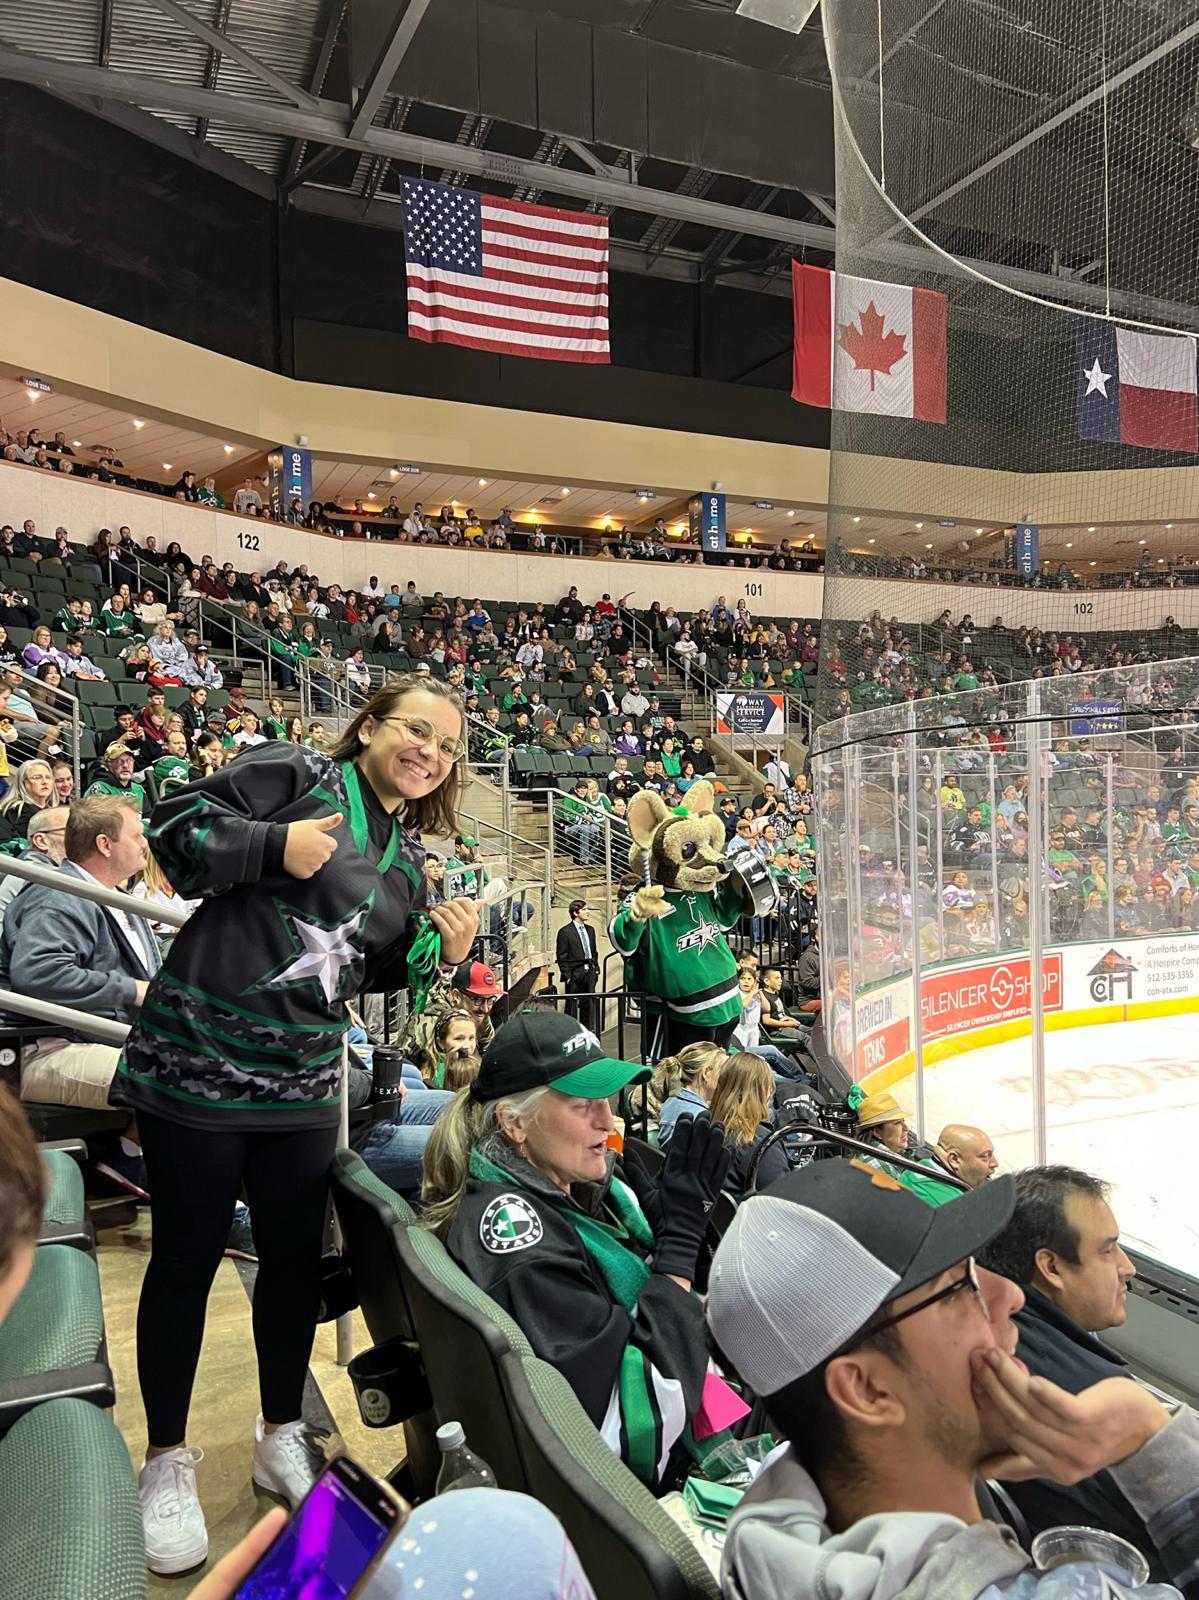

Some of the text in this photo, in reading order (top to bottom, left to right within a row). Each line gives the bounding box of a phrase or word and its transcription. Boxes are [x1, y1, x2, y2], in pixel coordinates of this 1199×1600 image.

[707, 497, 719, 549] at home
[237, 532, 260, 552] 122
[1021, 528, 1032, 573] at home
[744, 583, 762, 597] 101
[1073, 602, 1094, 615] 102
[736, 708, 765, 716] SERVICE
[1146, 945, 1179, 955] Comforts
[1179, 943, 1187, 952] of
[1146, 960, 1153, 968] A
[1153, 959, 1181, 969] Hospice
[1146, 970, 1194, 983] 512-535-3355
[1146, 986, 1189, 997] coh-atx.com
[884, 994, 893, 1021] IN
[920, 983, 987, 1019] SILENCER
[946, 1019, 971, 1032] SILENCER
[863, 1036, 886, 1071] TEXAS
[483, 1197, 536, 1232] TEXAS
[490, 1228, 540, 1249] STARS
